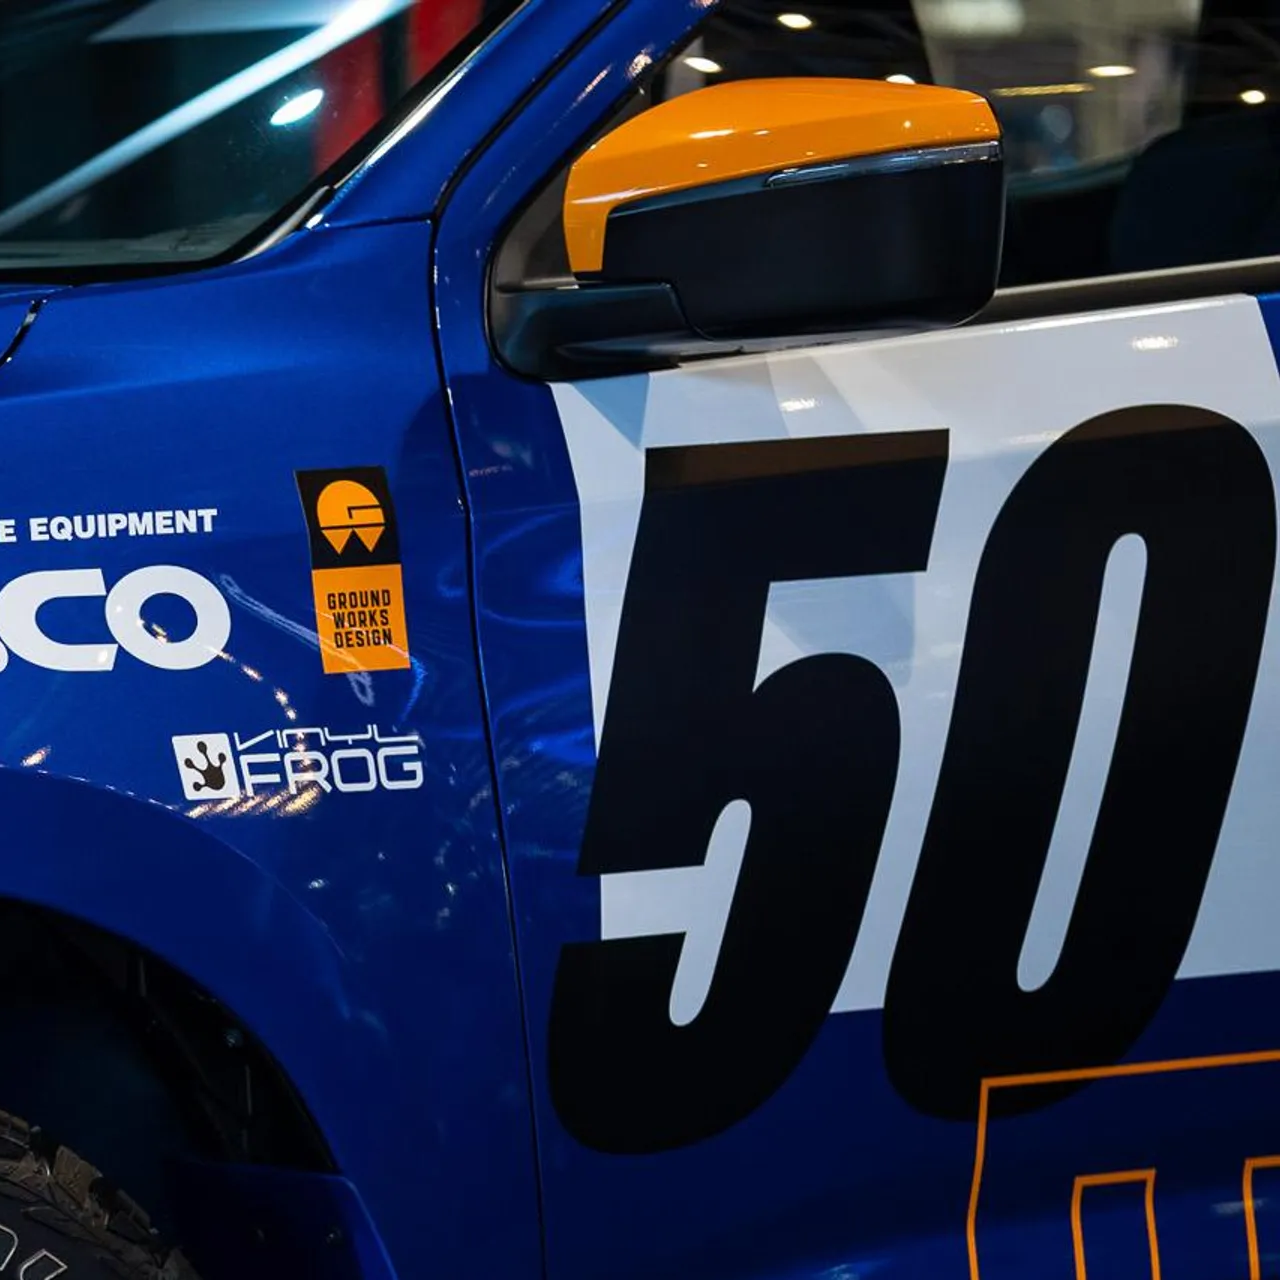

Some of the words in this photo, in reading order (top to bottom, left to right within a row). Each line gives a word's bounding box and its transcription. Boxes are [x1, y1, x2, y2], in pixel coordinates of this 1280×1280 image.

[29, 508, 218, 542] EQUIPMENT
[327, 589, 391, 610] GROUND
[332, 609, 389, 629] WORKS
[334, 628, 393, 648] DESIGN
[240, 745, 423, 797] FROG
[546, 403, 1278, 1155] 50
